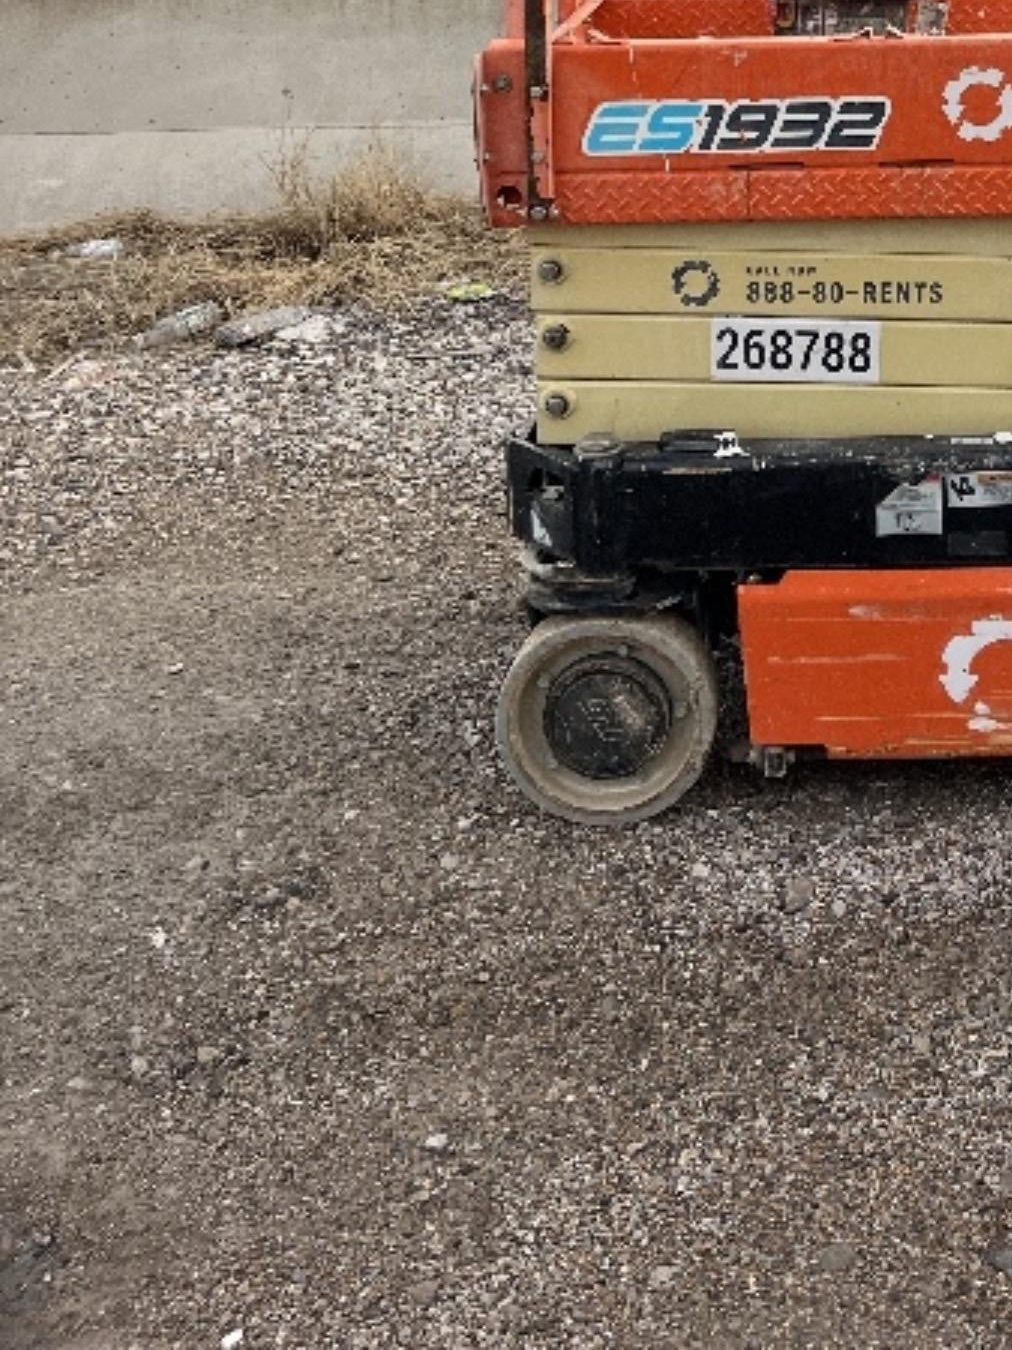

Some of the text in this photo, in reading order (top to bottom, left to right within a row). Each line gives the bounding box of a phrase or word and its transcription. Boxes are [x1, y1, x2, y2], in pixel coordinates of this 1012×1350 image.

[584, 99, 890, 154] ES1932
[746, 281, 944, 304] 888-80-RENTS
[715, 327, 872, 373] 268788
